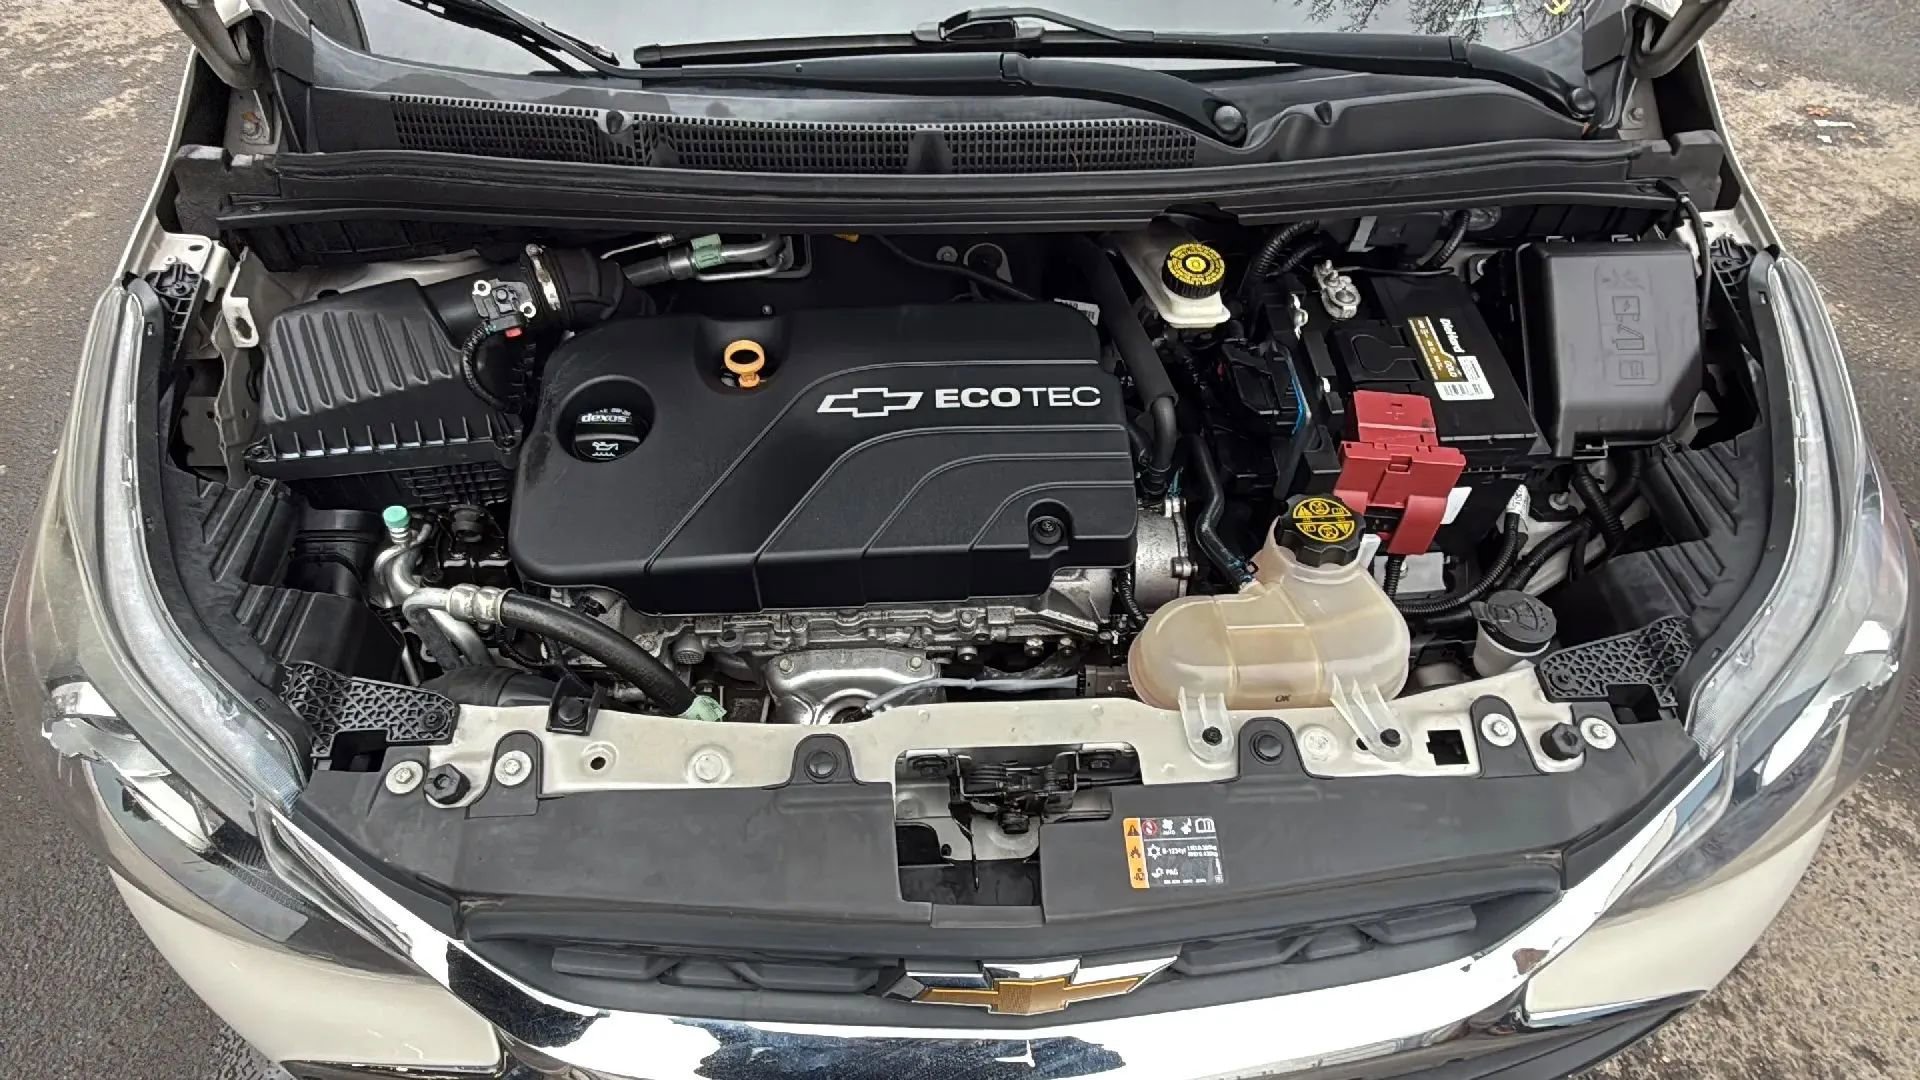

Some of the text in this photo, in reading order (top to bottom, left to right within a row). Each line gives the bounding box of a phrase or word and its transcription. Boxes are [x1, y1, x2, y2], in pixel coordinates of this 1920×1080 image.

[1440, 318, 1465, 353] DieHard
[935, 386, 1101, 408] ECOTEC
[581, 413, 627, 423] dexos
